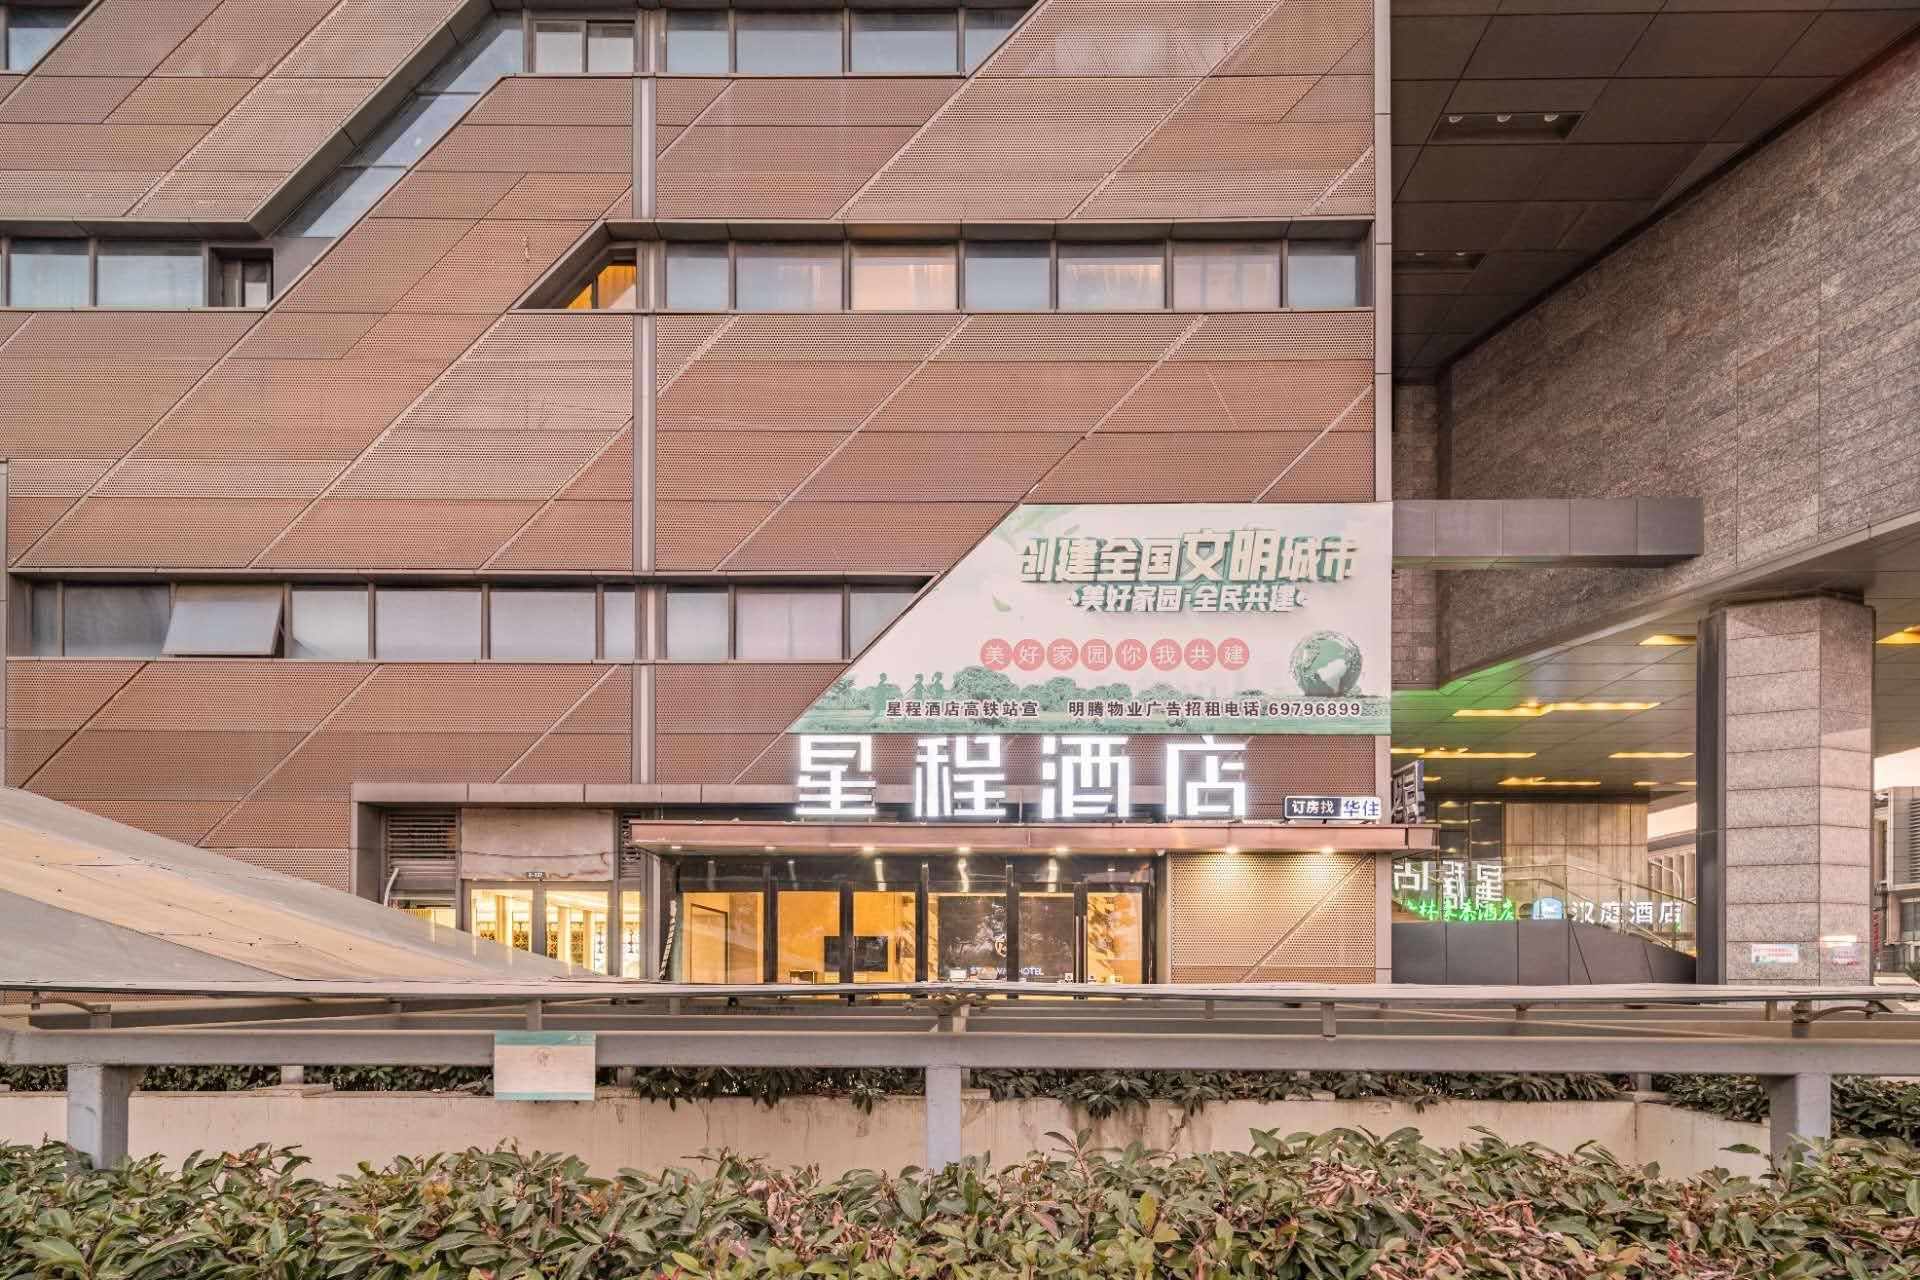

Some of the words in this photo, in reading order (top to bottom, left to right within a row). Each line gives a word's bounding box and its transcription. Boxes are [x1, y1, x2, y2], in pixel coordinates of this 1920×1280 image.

[1019, 529, 1358, 583] 创建全国文明城市
[985, 638, 1245, 665] 美好家园你我共建
[886, 700, 1039, 718] 星程酒店高铁站宣
[1068, 700, 1260, 718] 明腾物业广告招租电话
[1268, 701, 1361, 717] 69796899
[795, 735, 1247, 818] 星程酒店
[1571, 900, 1682, 924] 汉庭酒店
